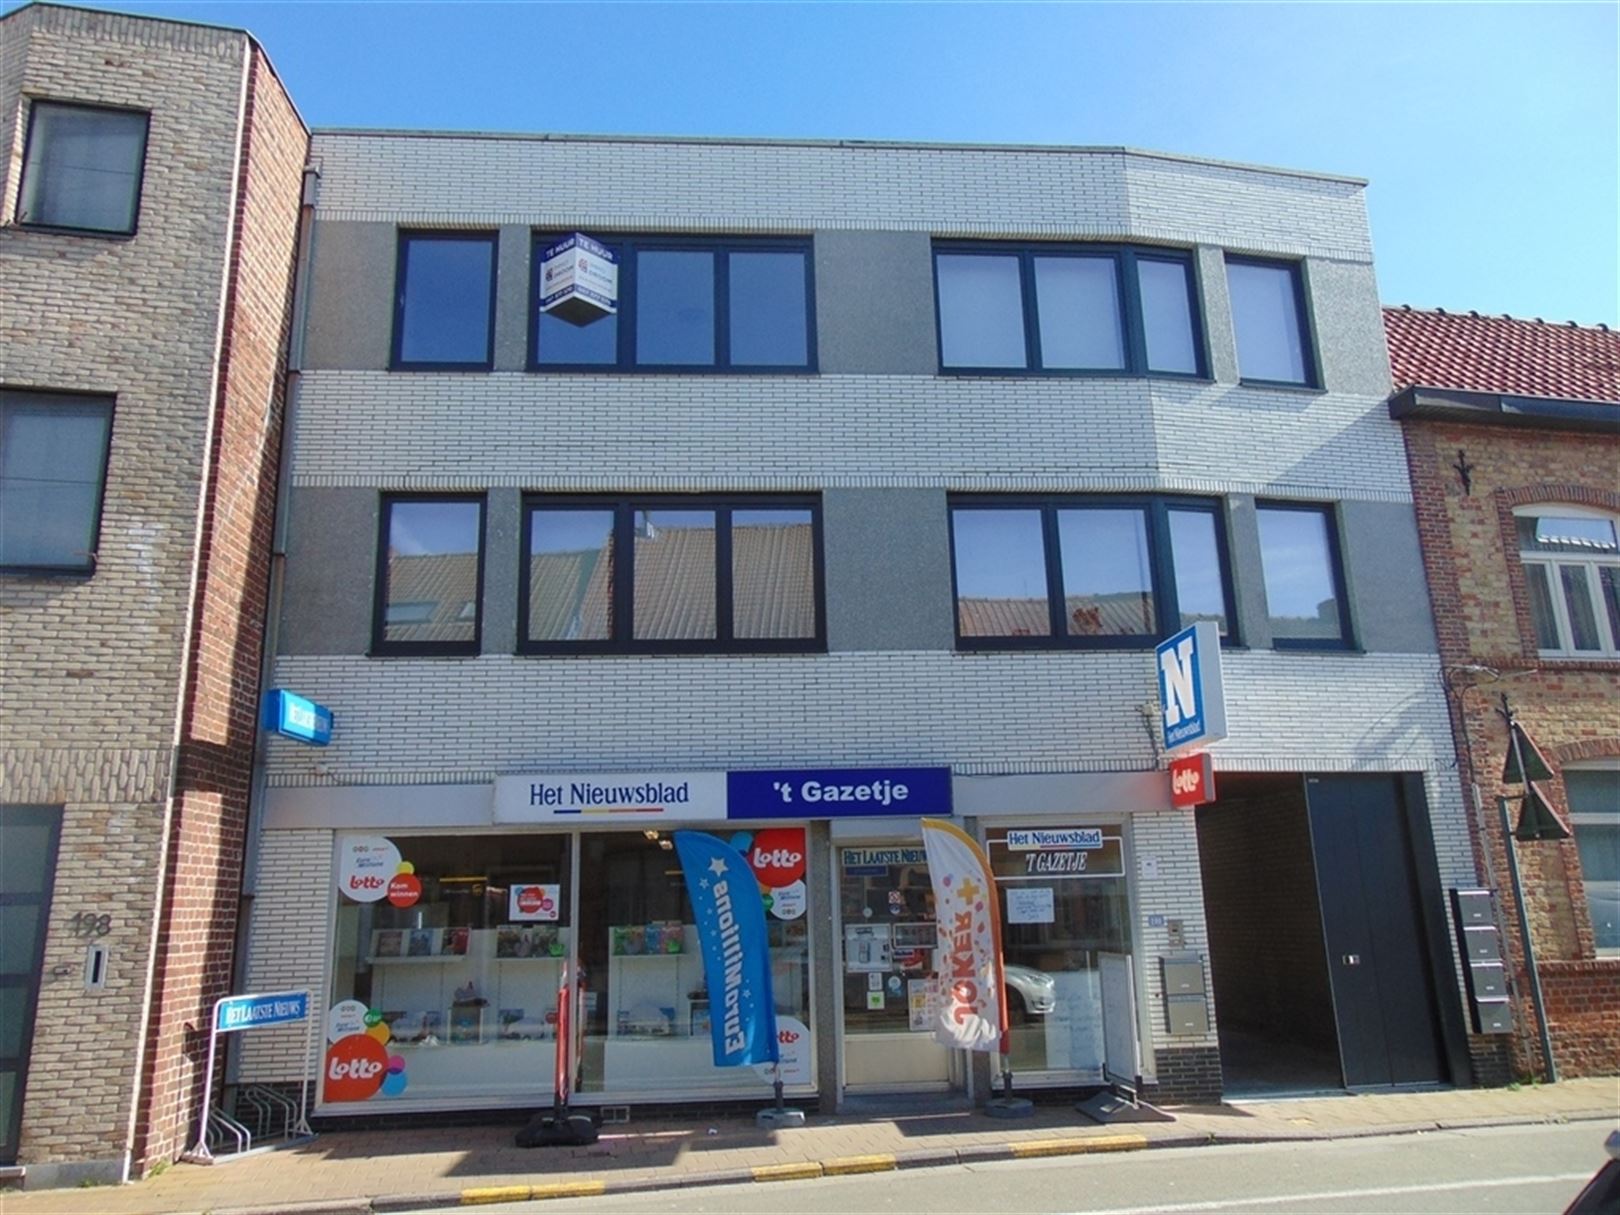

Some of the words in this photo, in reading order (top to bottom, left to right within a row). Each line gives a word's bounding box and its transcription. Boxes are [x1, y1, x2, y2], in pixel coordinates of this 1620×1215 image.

[1160, 636, 1195, 728] N
[530, 783, 562, 805] Het
[570, 782, 689, 804] Nieuwsblad
[773, 782, 792, 802] 't
[801, 780, 909, 805] Gazetje
[1009, 832, 1030, 845] Het
[1032, 831, 1101, 844] Nieuwsblad
[844, 850, 863, 864] HET
[863, 850, 901, 864] LAATSTE
[1037, 852, 1088, 872] GAZETJE
[70, 911, 112, 937] 198
[240, 1003, 273, 1023] LAATSTE
